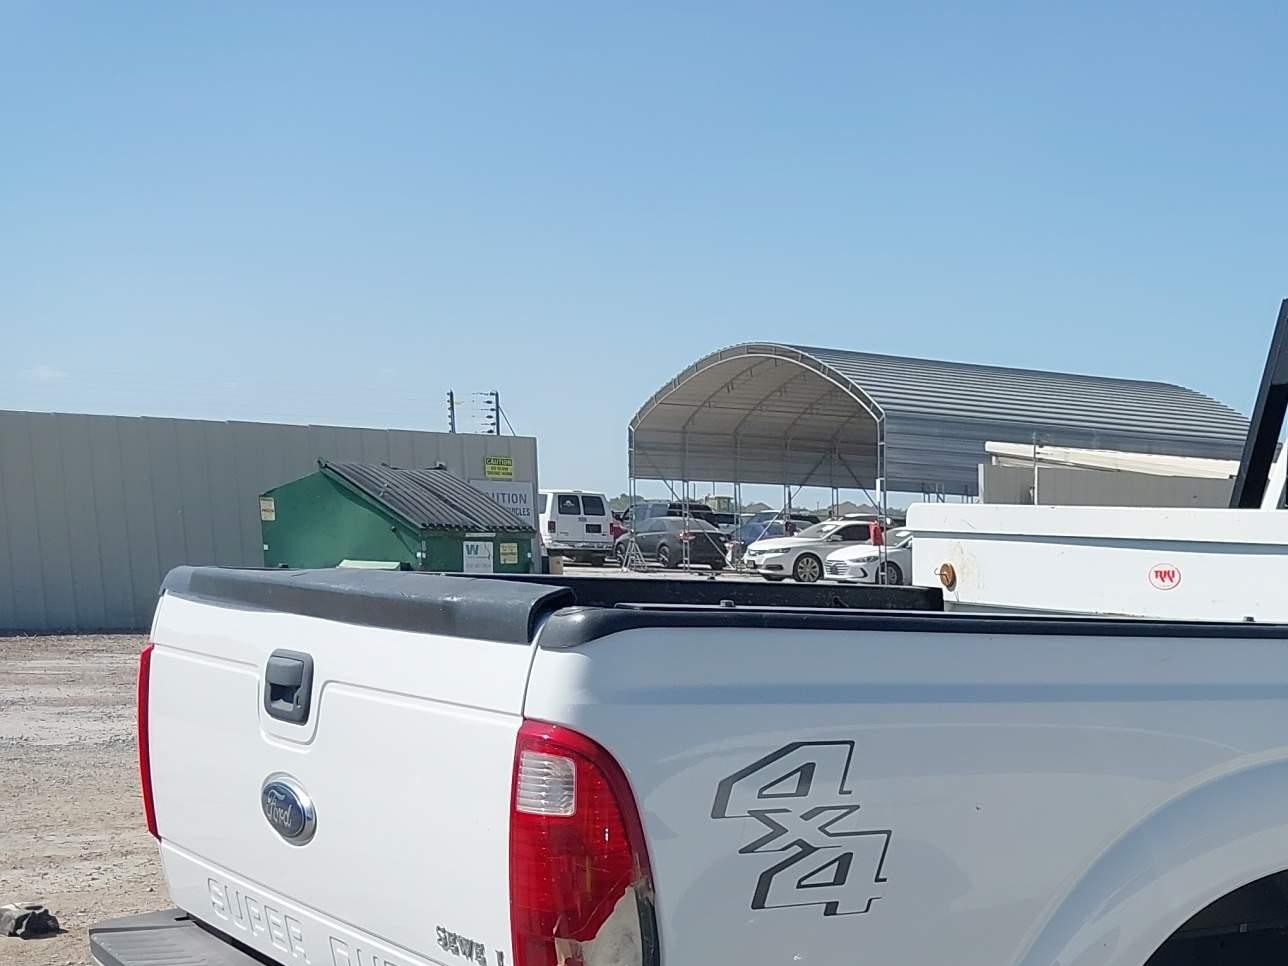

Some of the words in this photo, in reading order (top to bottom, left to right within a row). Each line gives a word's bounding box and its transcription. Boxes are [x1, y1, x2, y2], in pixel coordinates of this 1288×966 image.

[486, 458, 512, 466] CAUTION
[266, 789, 293, 827] Ford
[208, 878, 312, 966] SUPER
